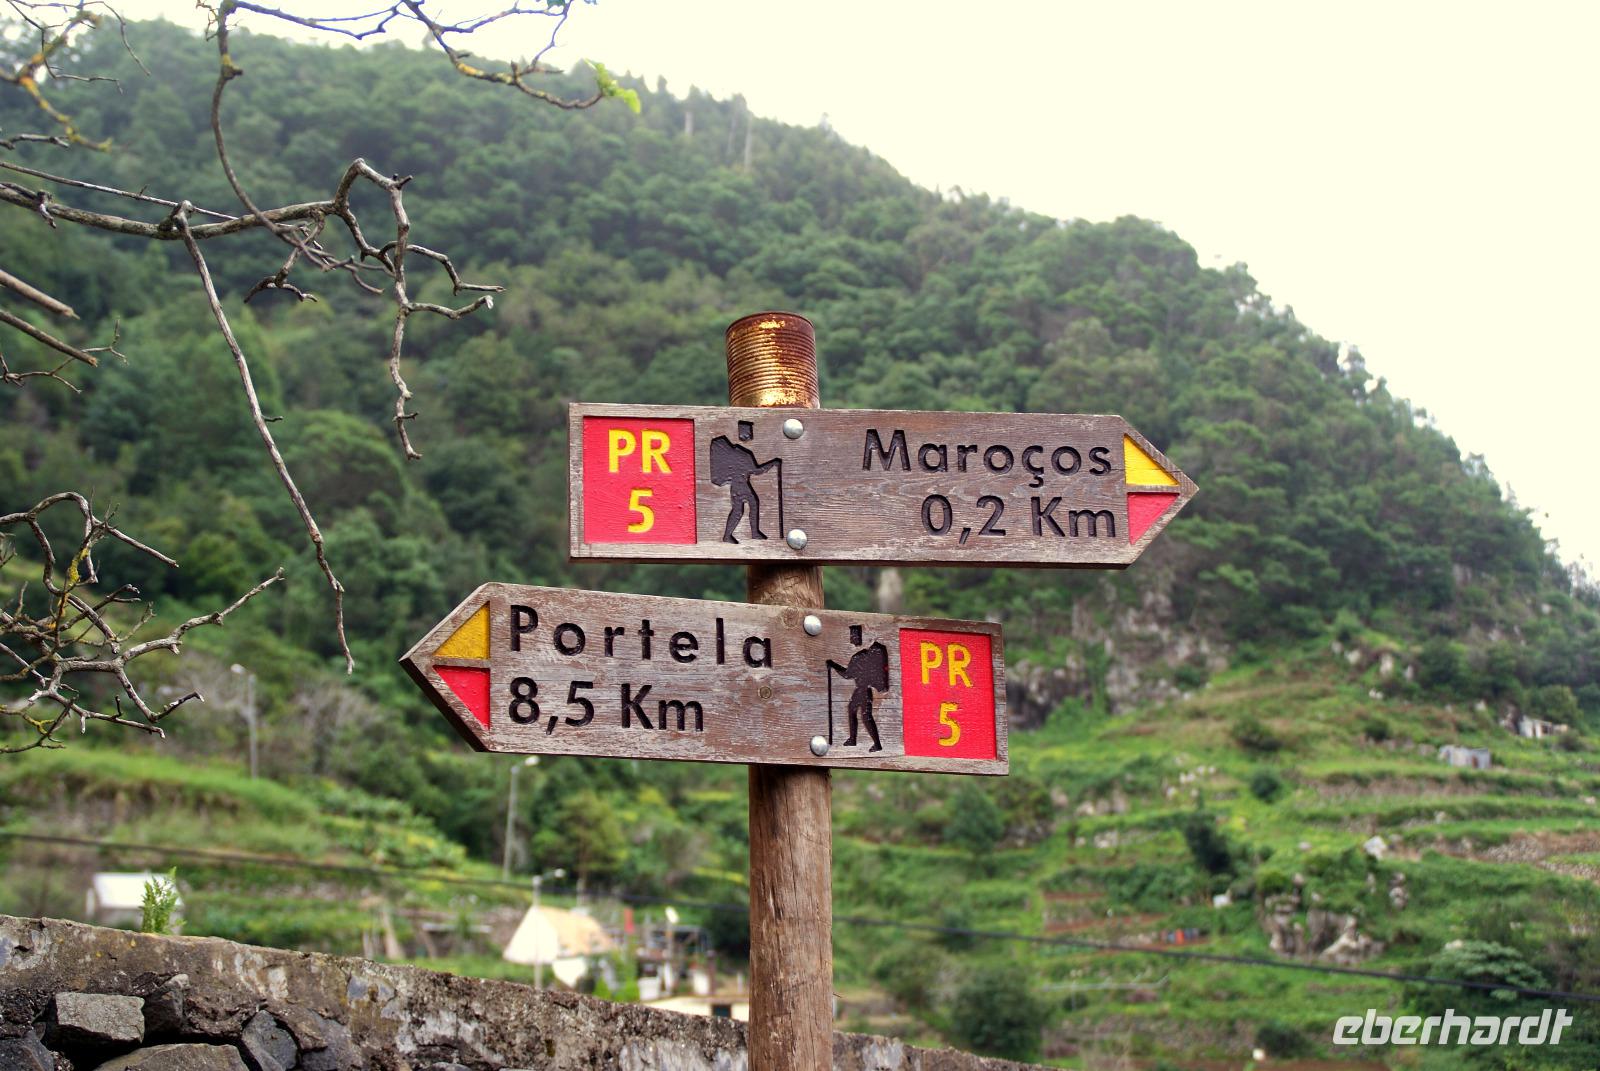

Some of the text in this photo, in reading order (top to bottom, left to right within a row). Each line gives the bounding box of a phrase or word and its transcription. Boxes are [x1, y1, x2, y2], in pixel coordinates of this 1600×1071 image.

[608, 429, 672, 474] PR
[862, 428, 1112, 488] Maroços
[627, 487, 655, 533] 5
[921, 494, 1116, 545] 0,2 Km
[510, 604, 772, 668] Portela
[920, 640, 973, 688] PR
[508, 677, 704, 735] 8,5 Km
[938, 702, 961, 747] 5
